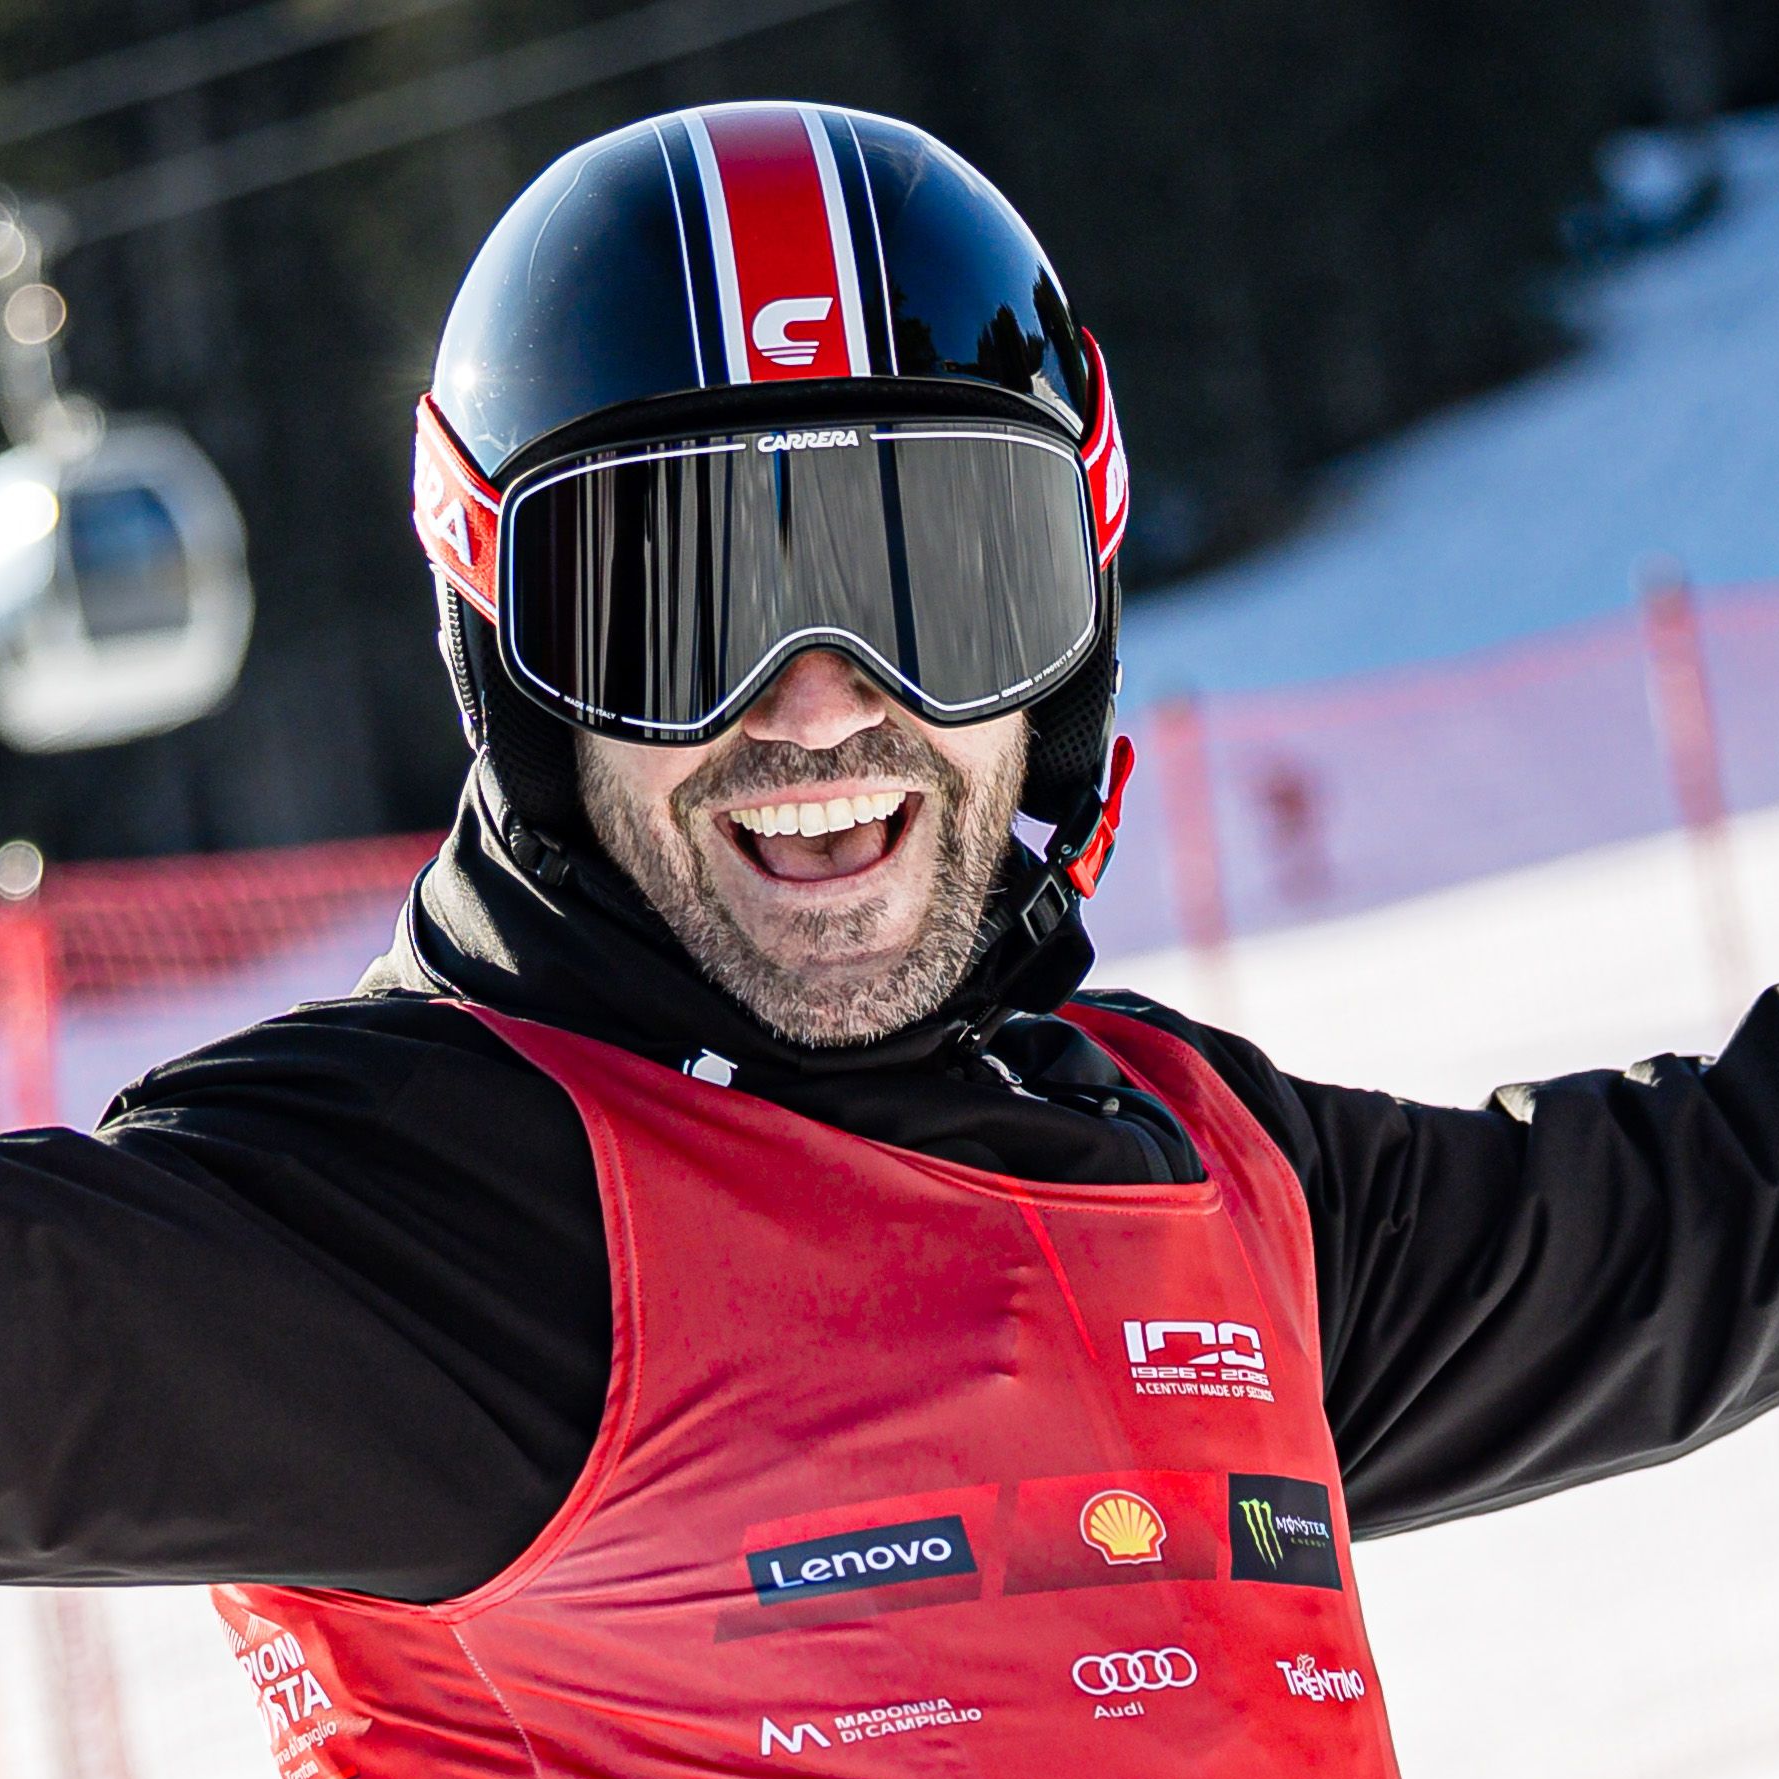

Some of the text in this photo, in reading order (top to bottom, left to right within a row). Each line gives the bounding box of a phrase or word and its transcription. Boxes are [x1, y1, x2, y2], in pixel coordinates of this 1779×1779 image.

[757, 430, 859, 453] CARRERA
[1131, 1367, 1198, 1379] 1926
[1220, 1369, 1270, 1386] 2026
[1135, 1382, 1146, 1395] A
[1146, 1383, 1200, 1396] CENTURY
[1199, 1384, 1230, 1397] MADE
[1231, 1385, 1246, 1397] OF
[770, 1537, 952, 1589] Lenovo
[834, 1698, 953, 1731] MADONNA
[1094, 1702, 1145, 1720] Audi
[839, 1708, 983, 1744] DI CAMPIGLIO
